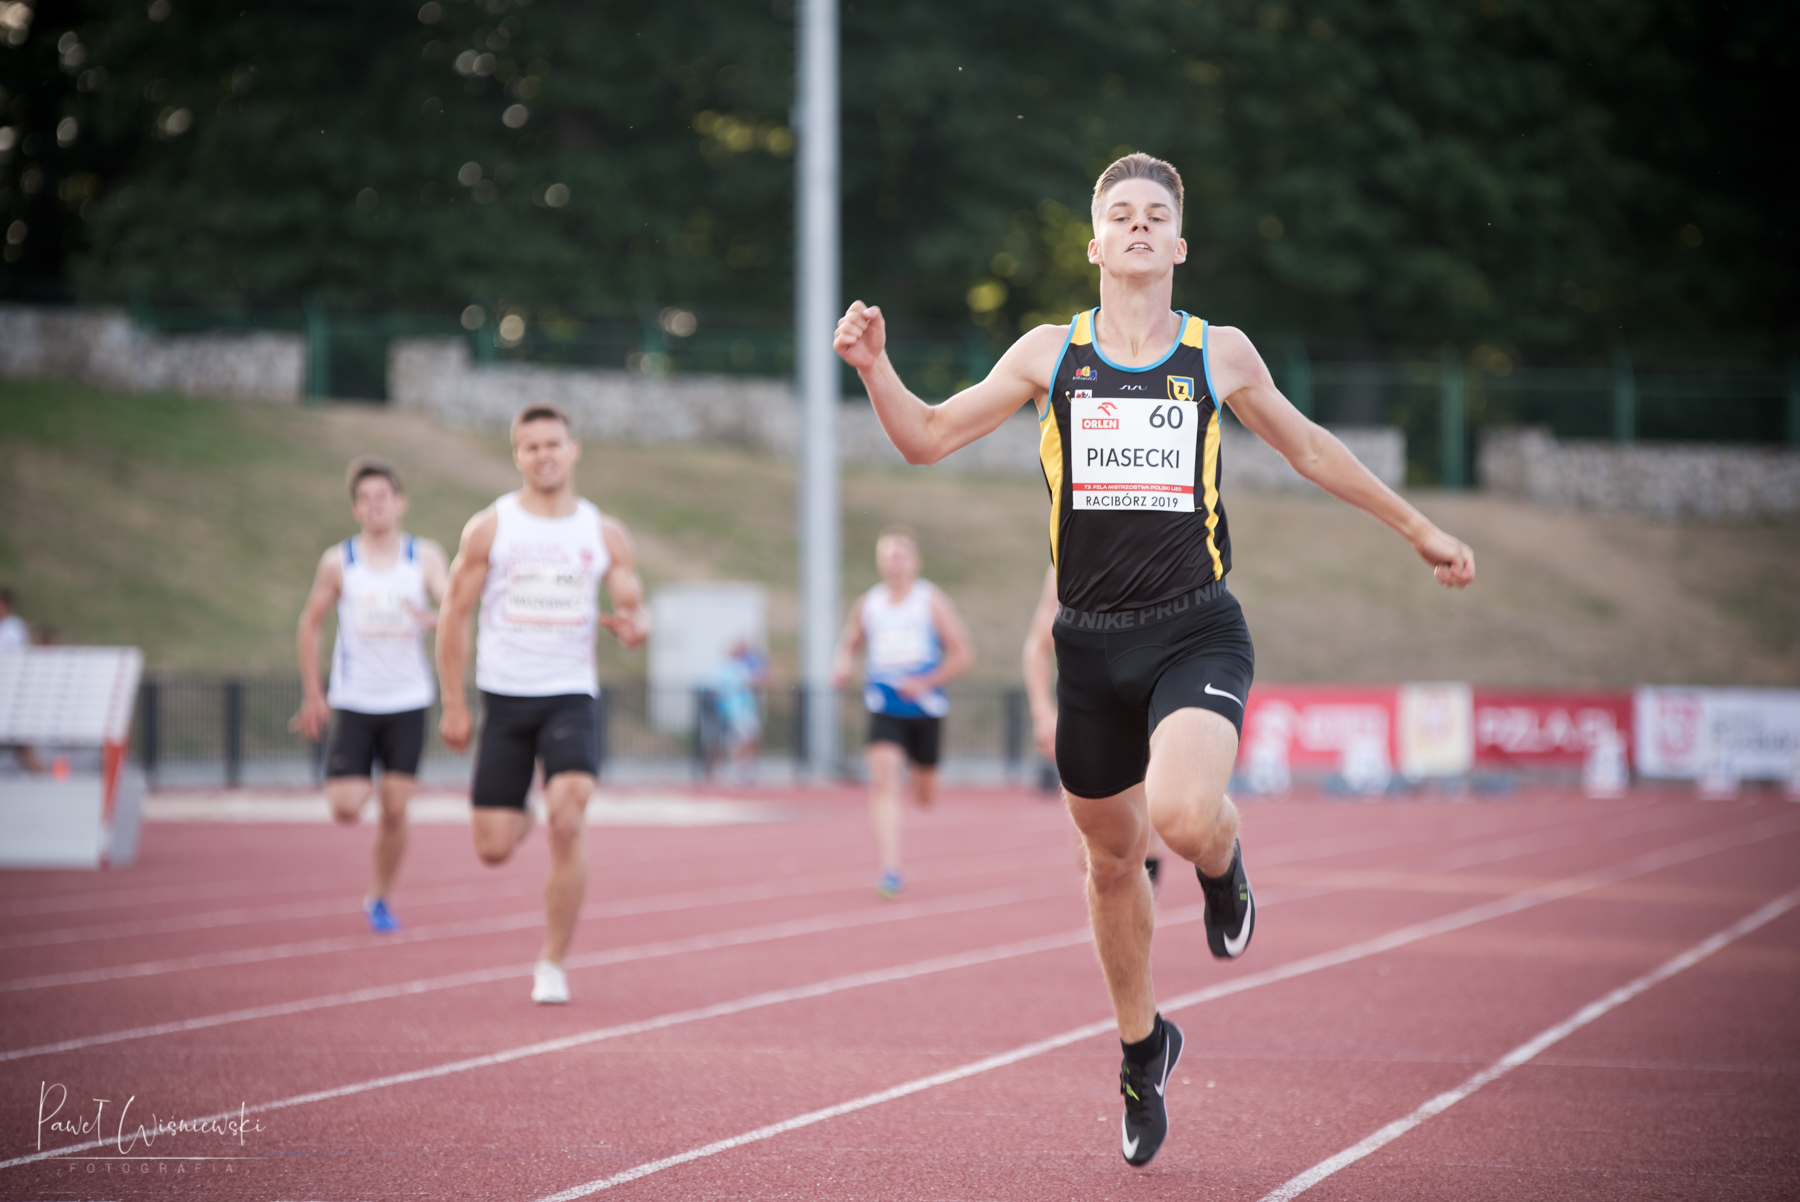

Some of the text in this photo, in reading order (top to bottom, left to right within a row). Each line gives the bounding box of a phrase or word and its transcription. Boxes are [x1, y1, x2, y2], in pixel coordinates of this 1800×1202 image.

[1083, 419, 1118, 429] ORLEN
[1149, 405, 1184, 429] 60
[1087, 448, 1180, 469] PIASECKI
[1086, 493, 1179, 508] RACIBÓRZ 2019
[1078, 610, 1135, 630] NIKE
[1139, 594, 1190, 625] PRO
